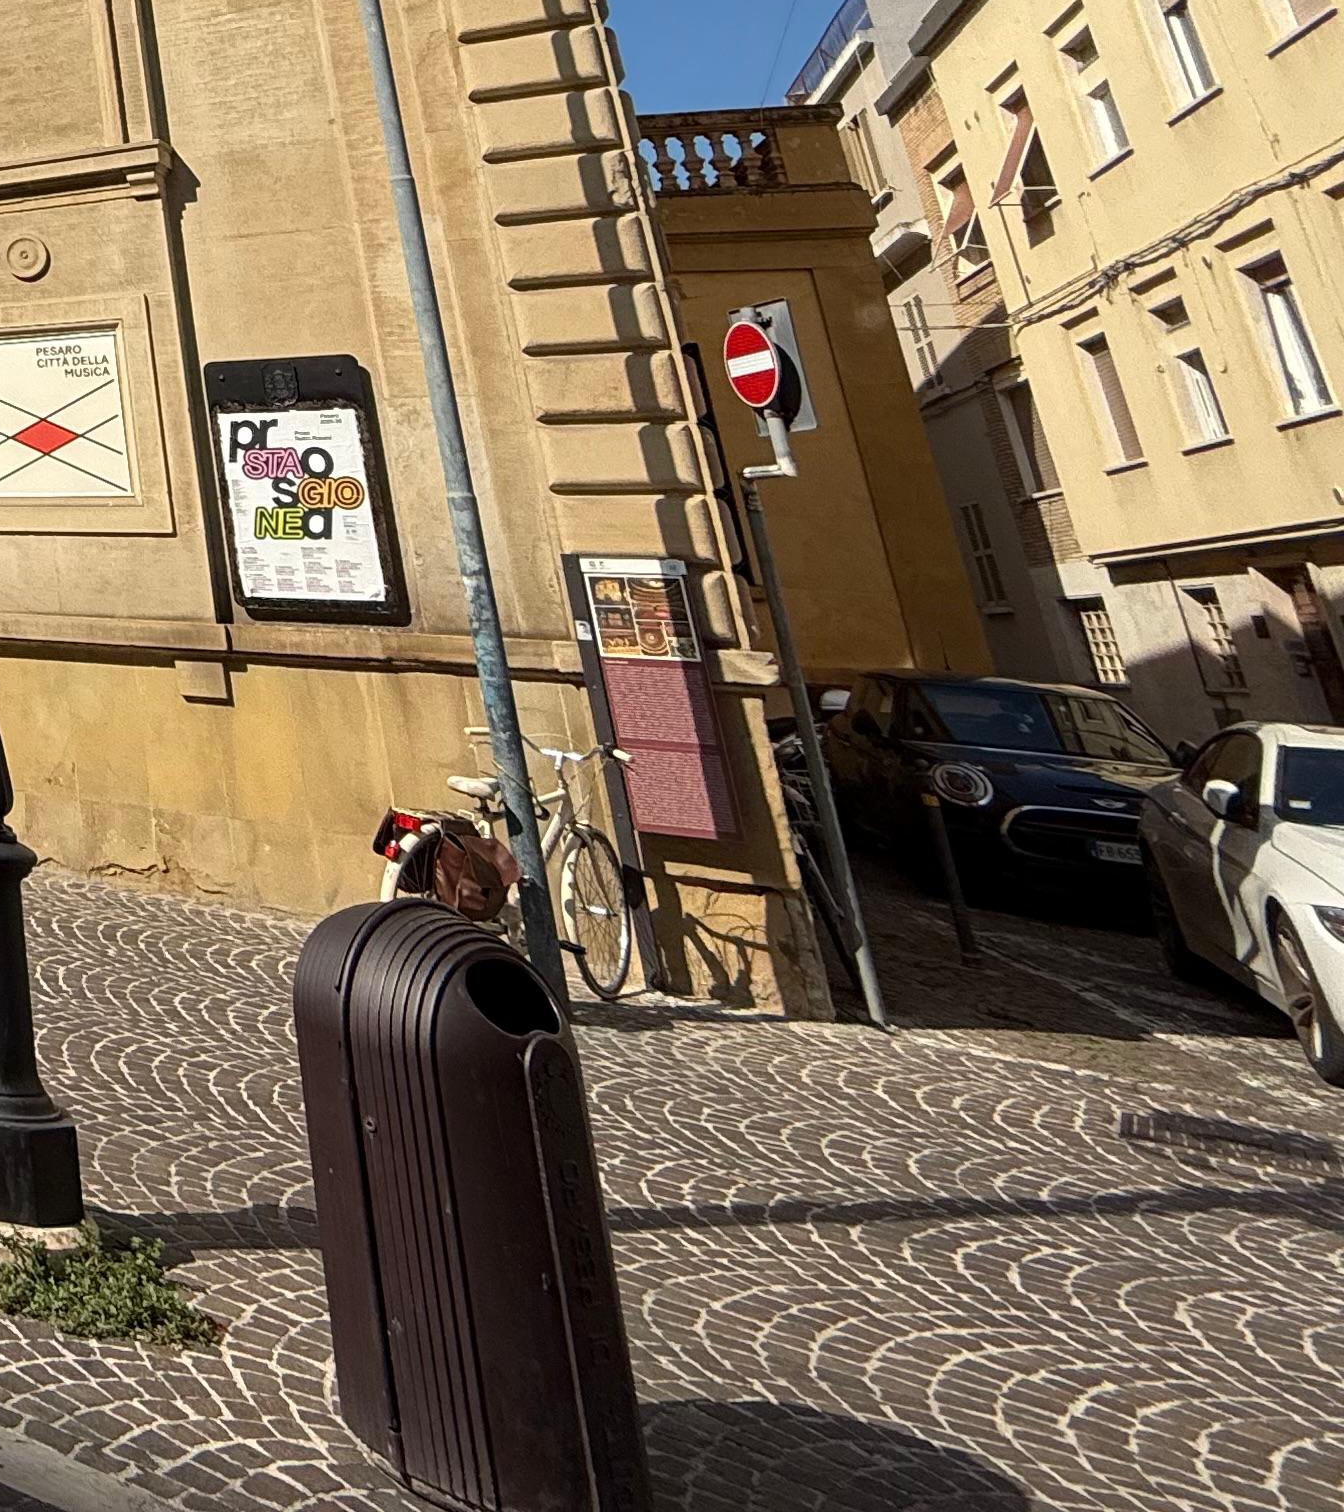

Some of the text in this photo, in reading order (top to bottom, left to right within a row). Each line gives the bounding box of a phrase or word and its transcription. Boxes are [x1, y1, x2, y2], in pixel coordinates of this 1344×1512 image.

[36, 345, 81, 356] PESARO
[36, 354, 109, 368] CITTÀ DELLA
[65, 367, 110, 378] MUSICA
[242, 447, 304, 479] STA
[297, 476, 365, 510] GIO
[254, 506, 305, 540] NE
